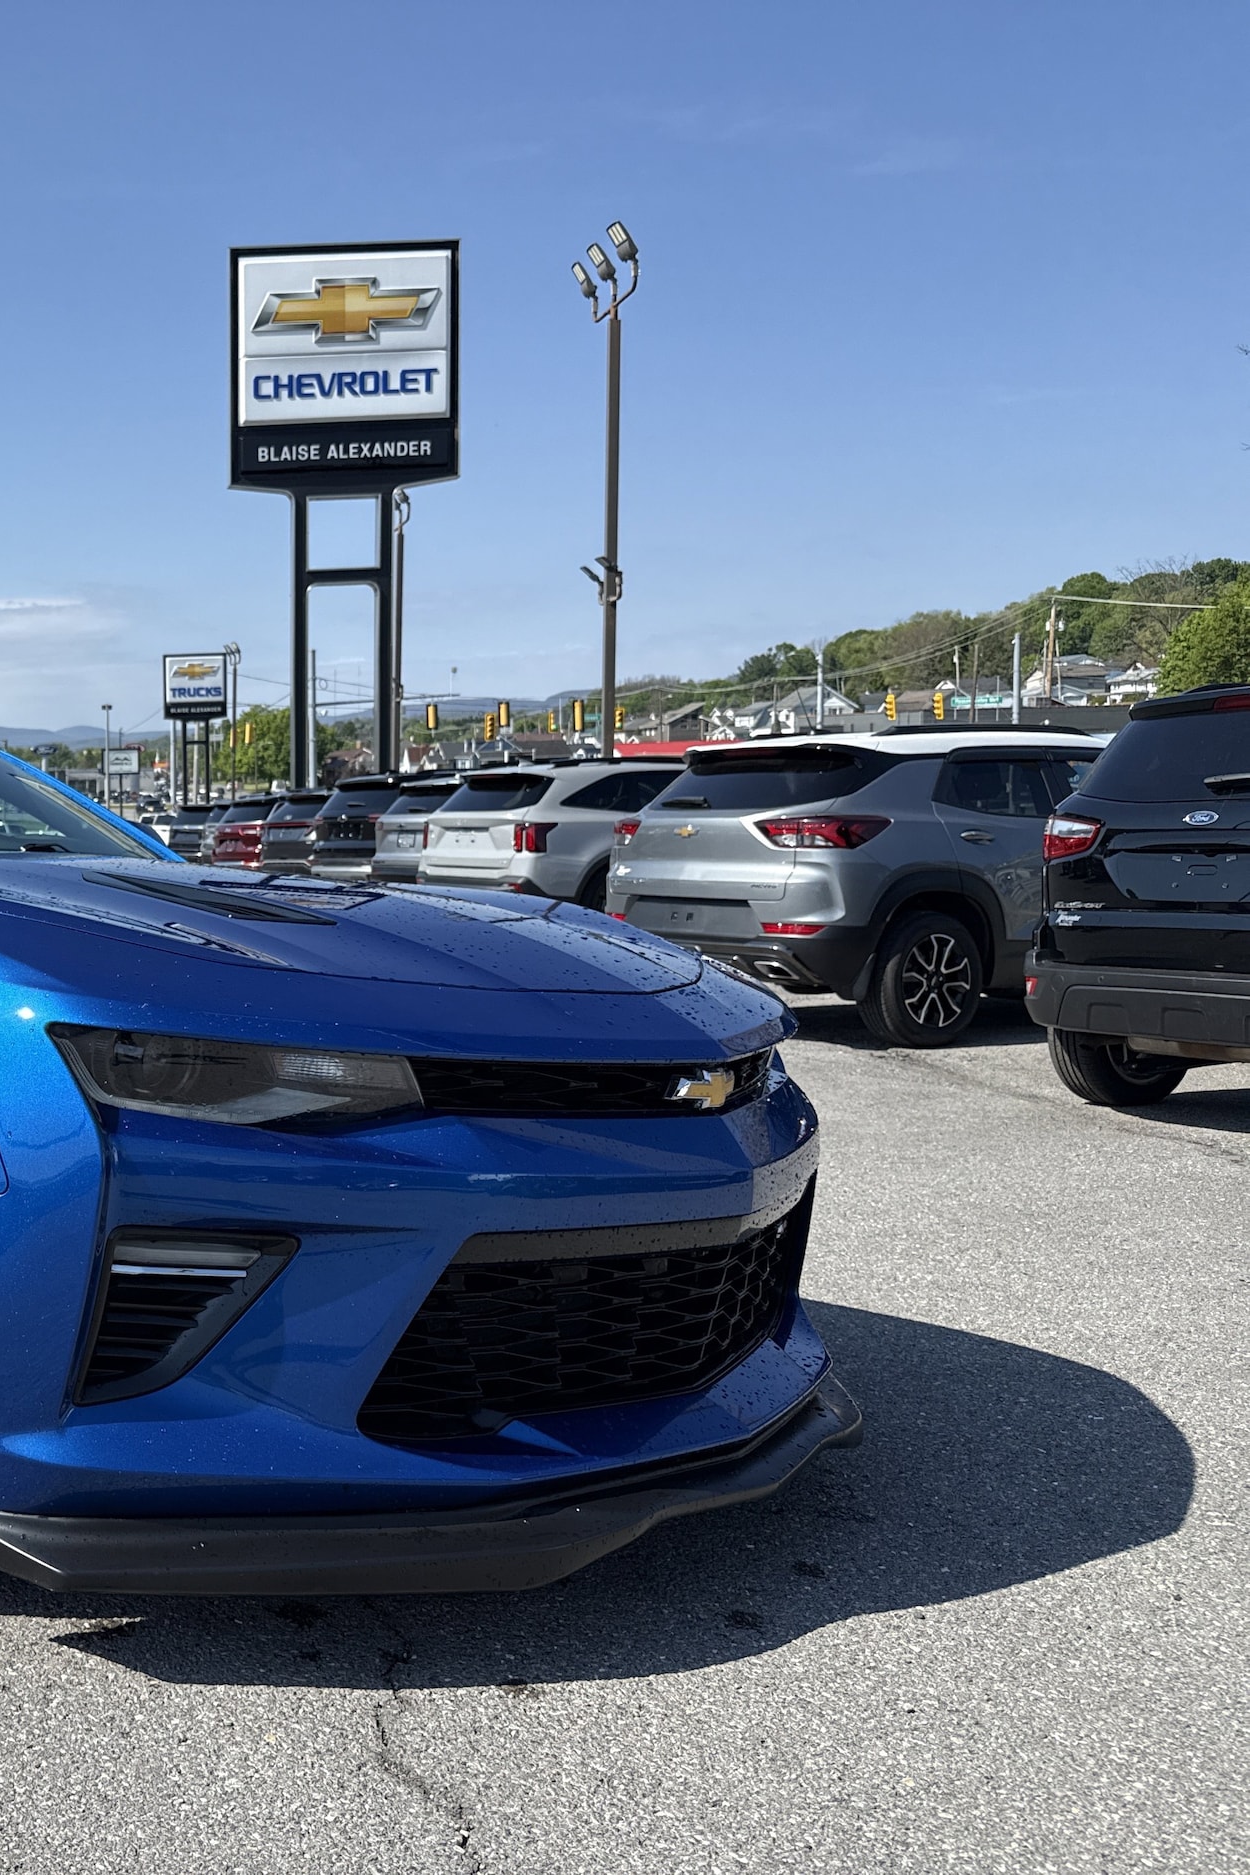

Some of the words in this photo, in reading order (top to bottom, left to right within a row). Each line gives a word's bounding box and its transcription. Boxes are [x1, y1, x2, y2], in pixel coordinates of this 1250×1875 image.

[253, 367, 439, 401] CHEVROLET
[257, 445, 321, 462] BLAISE
[326, 441, 432, 460] ALEXANDER
[170, 686, 222, 698] TRUCKS
